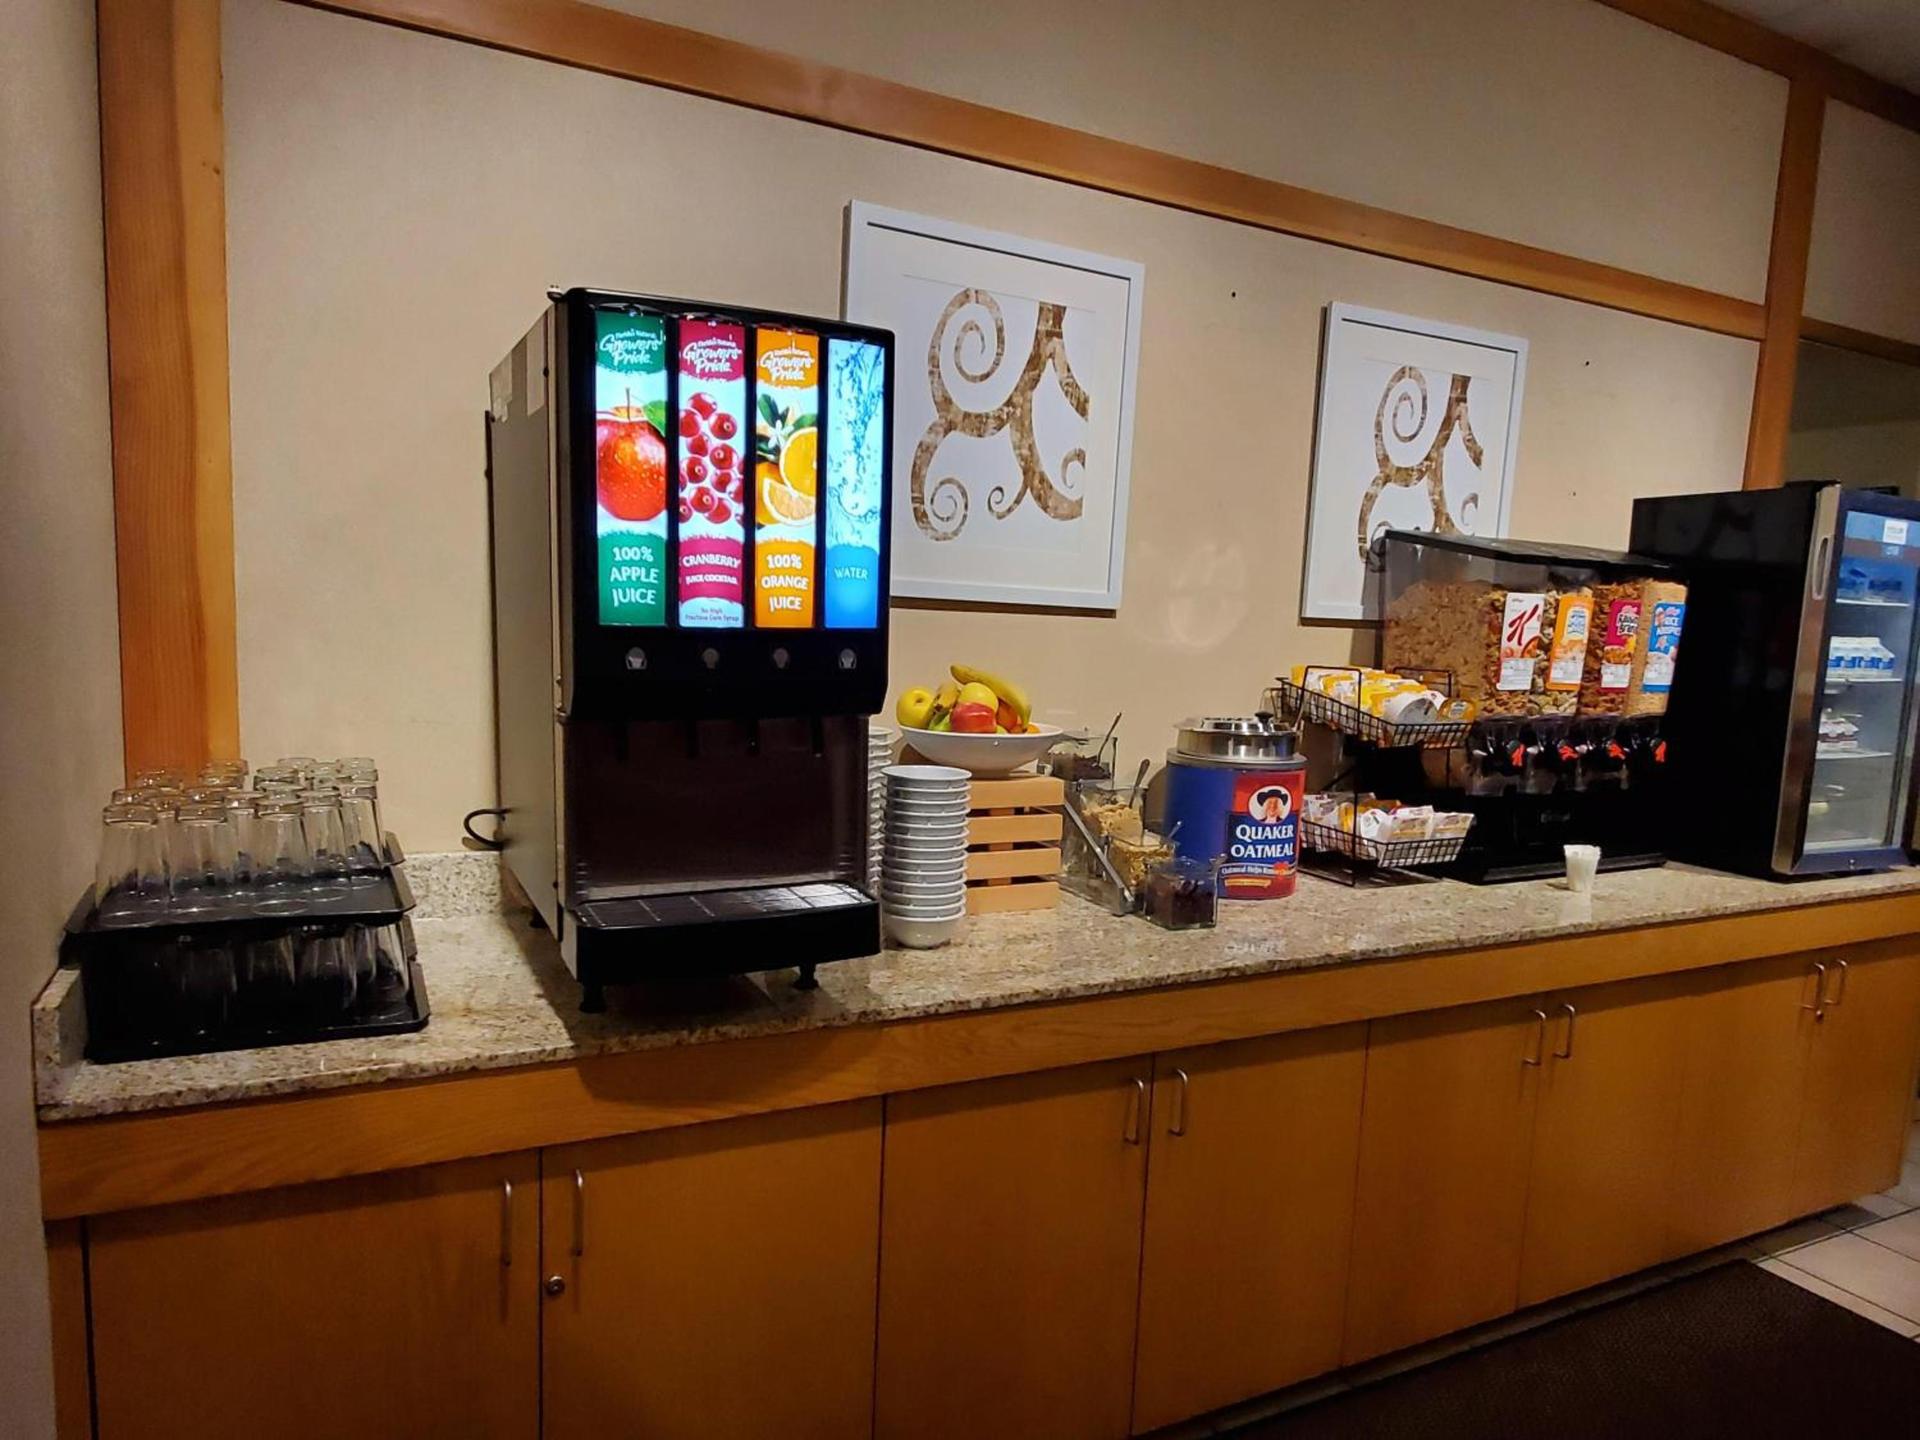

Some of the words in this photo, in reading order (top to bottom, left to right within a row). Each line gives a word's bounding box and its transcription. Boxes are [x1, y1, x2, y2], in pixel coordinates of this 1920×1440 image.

[612, 349, 652, 366] Pride
[694, 358, 732, 373] Pride
[769, 366, 805, 381] Pride
[612, 546, 653, 561] 100%
[682, 553, 741, 569] CRANBERRY
[766, 553, 802, 569] 100%
[610, 566, 659, 583] APPLE
[834, 567, 868, 581] WATER
[761, 575, 809, 590] ORANGE
[612, 587, 656, 607] JUICE
[769, 596, 802, 613] JUICE
[1507, 604, 1539, 646] K
[1236, 824, 1294, 842] QUAKER
[1230, 843, 1294, 858] OATMEAL
